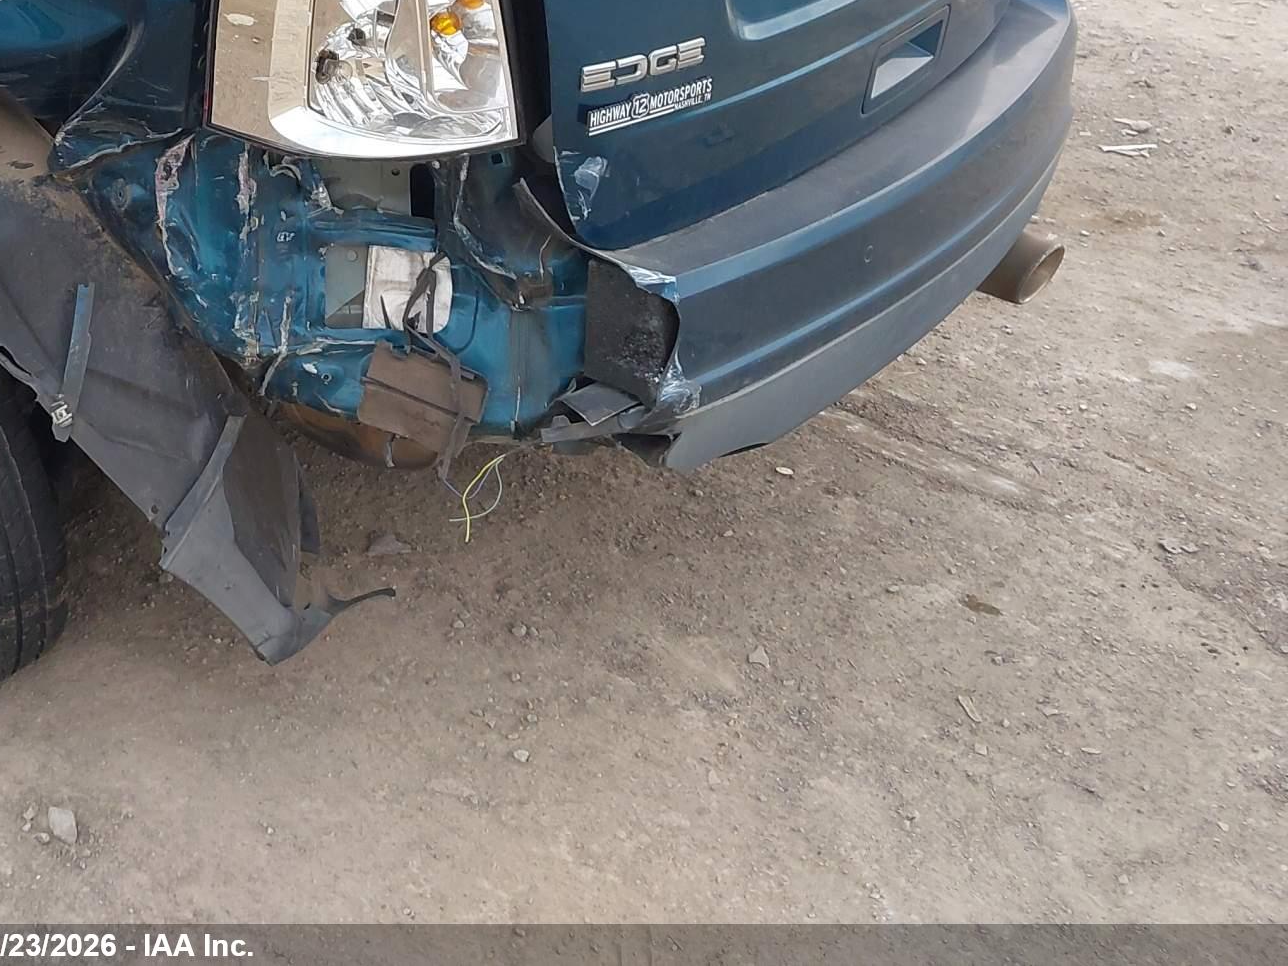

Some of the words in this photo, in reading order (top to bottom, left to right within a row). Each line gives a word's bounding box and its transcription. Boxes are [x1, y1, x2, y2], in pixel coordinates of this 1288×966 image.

[580, 36, 706, 93] EDGE
[589, 101, 632, 127] HIGHWAY
[634, 97, 648, 115] 12
[649, 78, 713, 110] MOTORSPORTS
